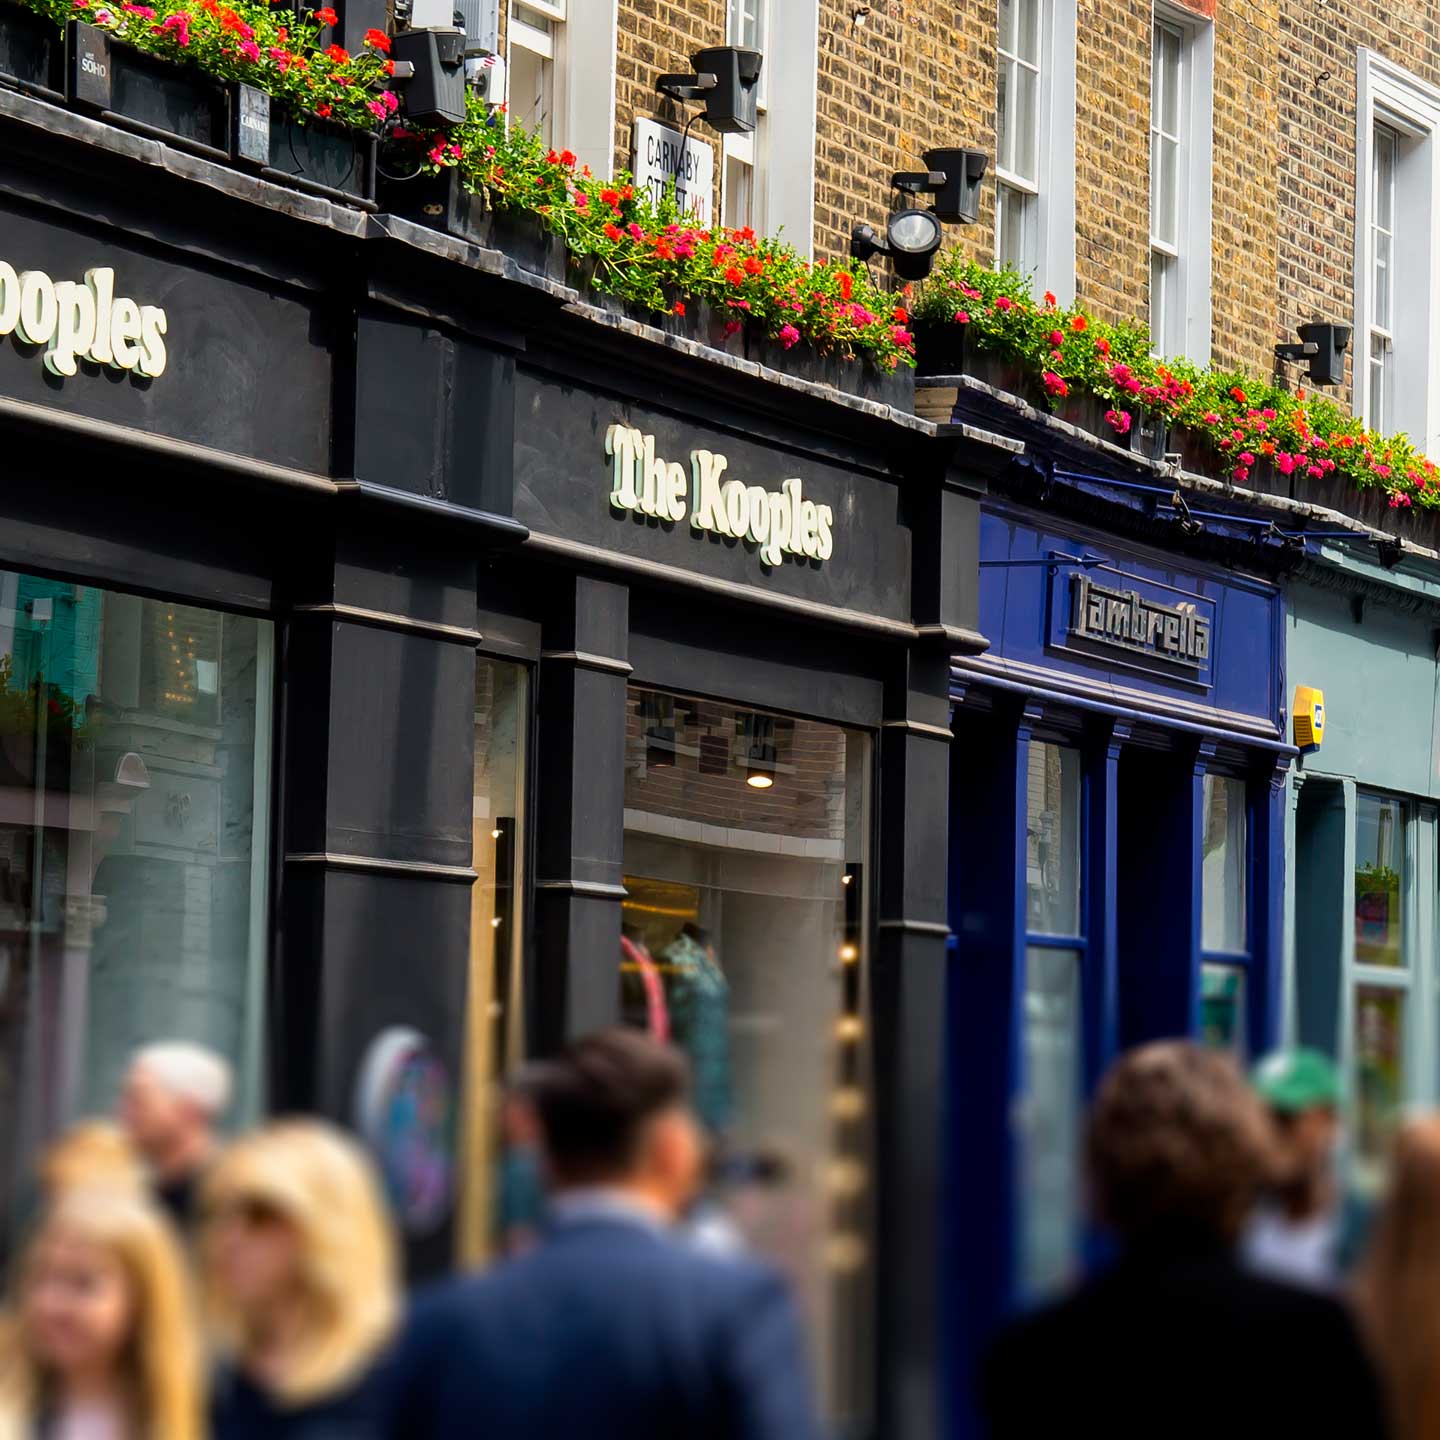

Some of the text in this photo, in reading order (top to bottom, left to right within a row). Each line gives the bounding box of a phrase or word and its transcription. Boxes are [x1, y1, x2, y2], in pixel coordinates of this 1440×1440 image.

[81, 58, 106, 78] SOHO
[647, 135, 700, 184] CARNABY
[605, 424, 834, 566] The Kooples
[1068, 572, 1210, 670] Lambretta
